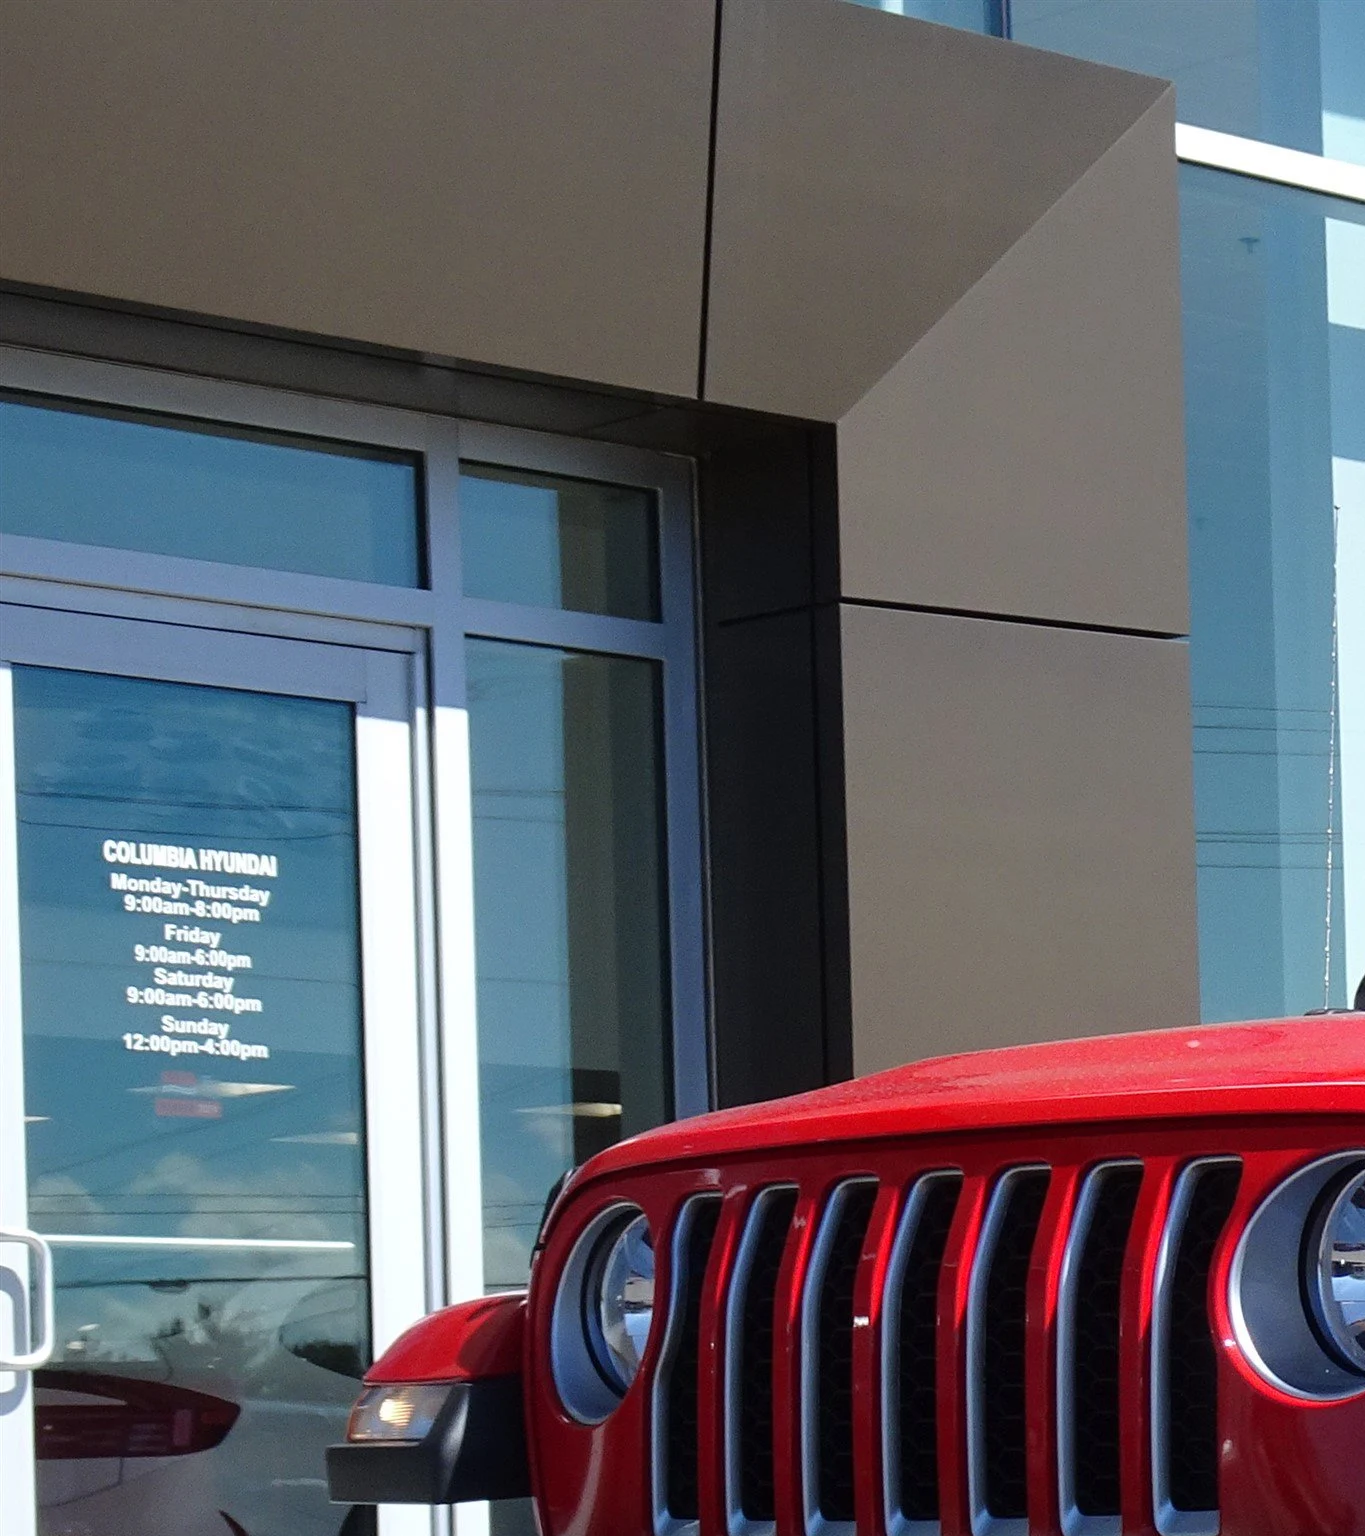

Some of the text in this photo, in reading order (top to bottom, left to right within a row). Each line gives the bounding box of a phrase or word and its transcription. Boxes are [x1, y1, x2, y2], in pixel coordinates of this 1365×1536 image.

[103, 839, 277, 877] COLUMBIA HYUNDAI
[110, 873, 271, 906] Monday-Thursday
[124, 894, 260, 924] 9:00am-8:00pm
[164, 924, 222, 948] Friday
[134, 944, 252, 971] 9:00am-6:00pm
[154, 967, 235, 993] Saturday
[127, 987, 263, 1014] 9:00am-6:00pm
[161, 1015, 230, 1040] Sunday
[122, 1033, 269, 1061] 12:00pm-4:00pm
